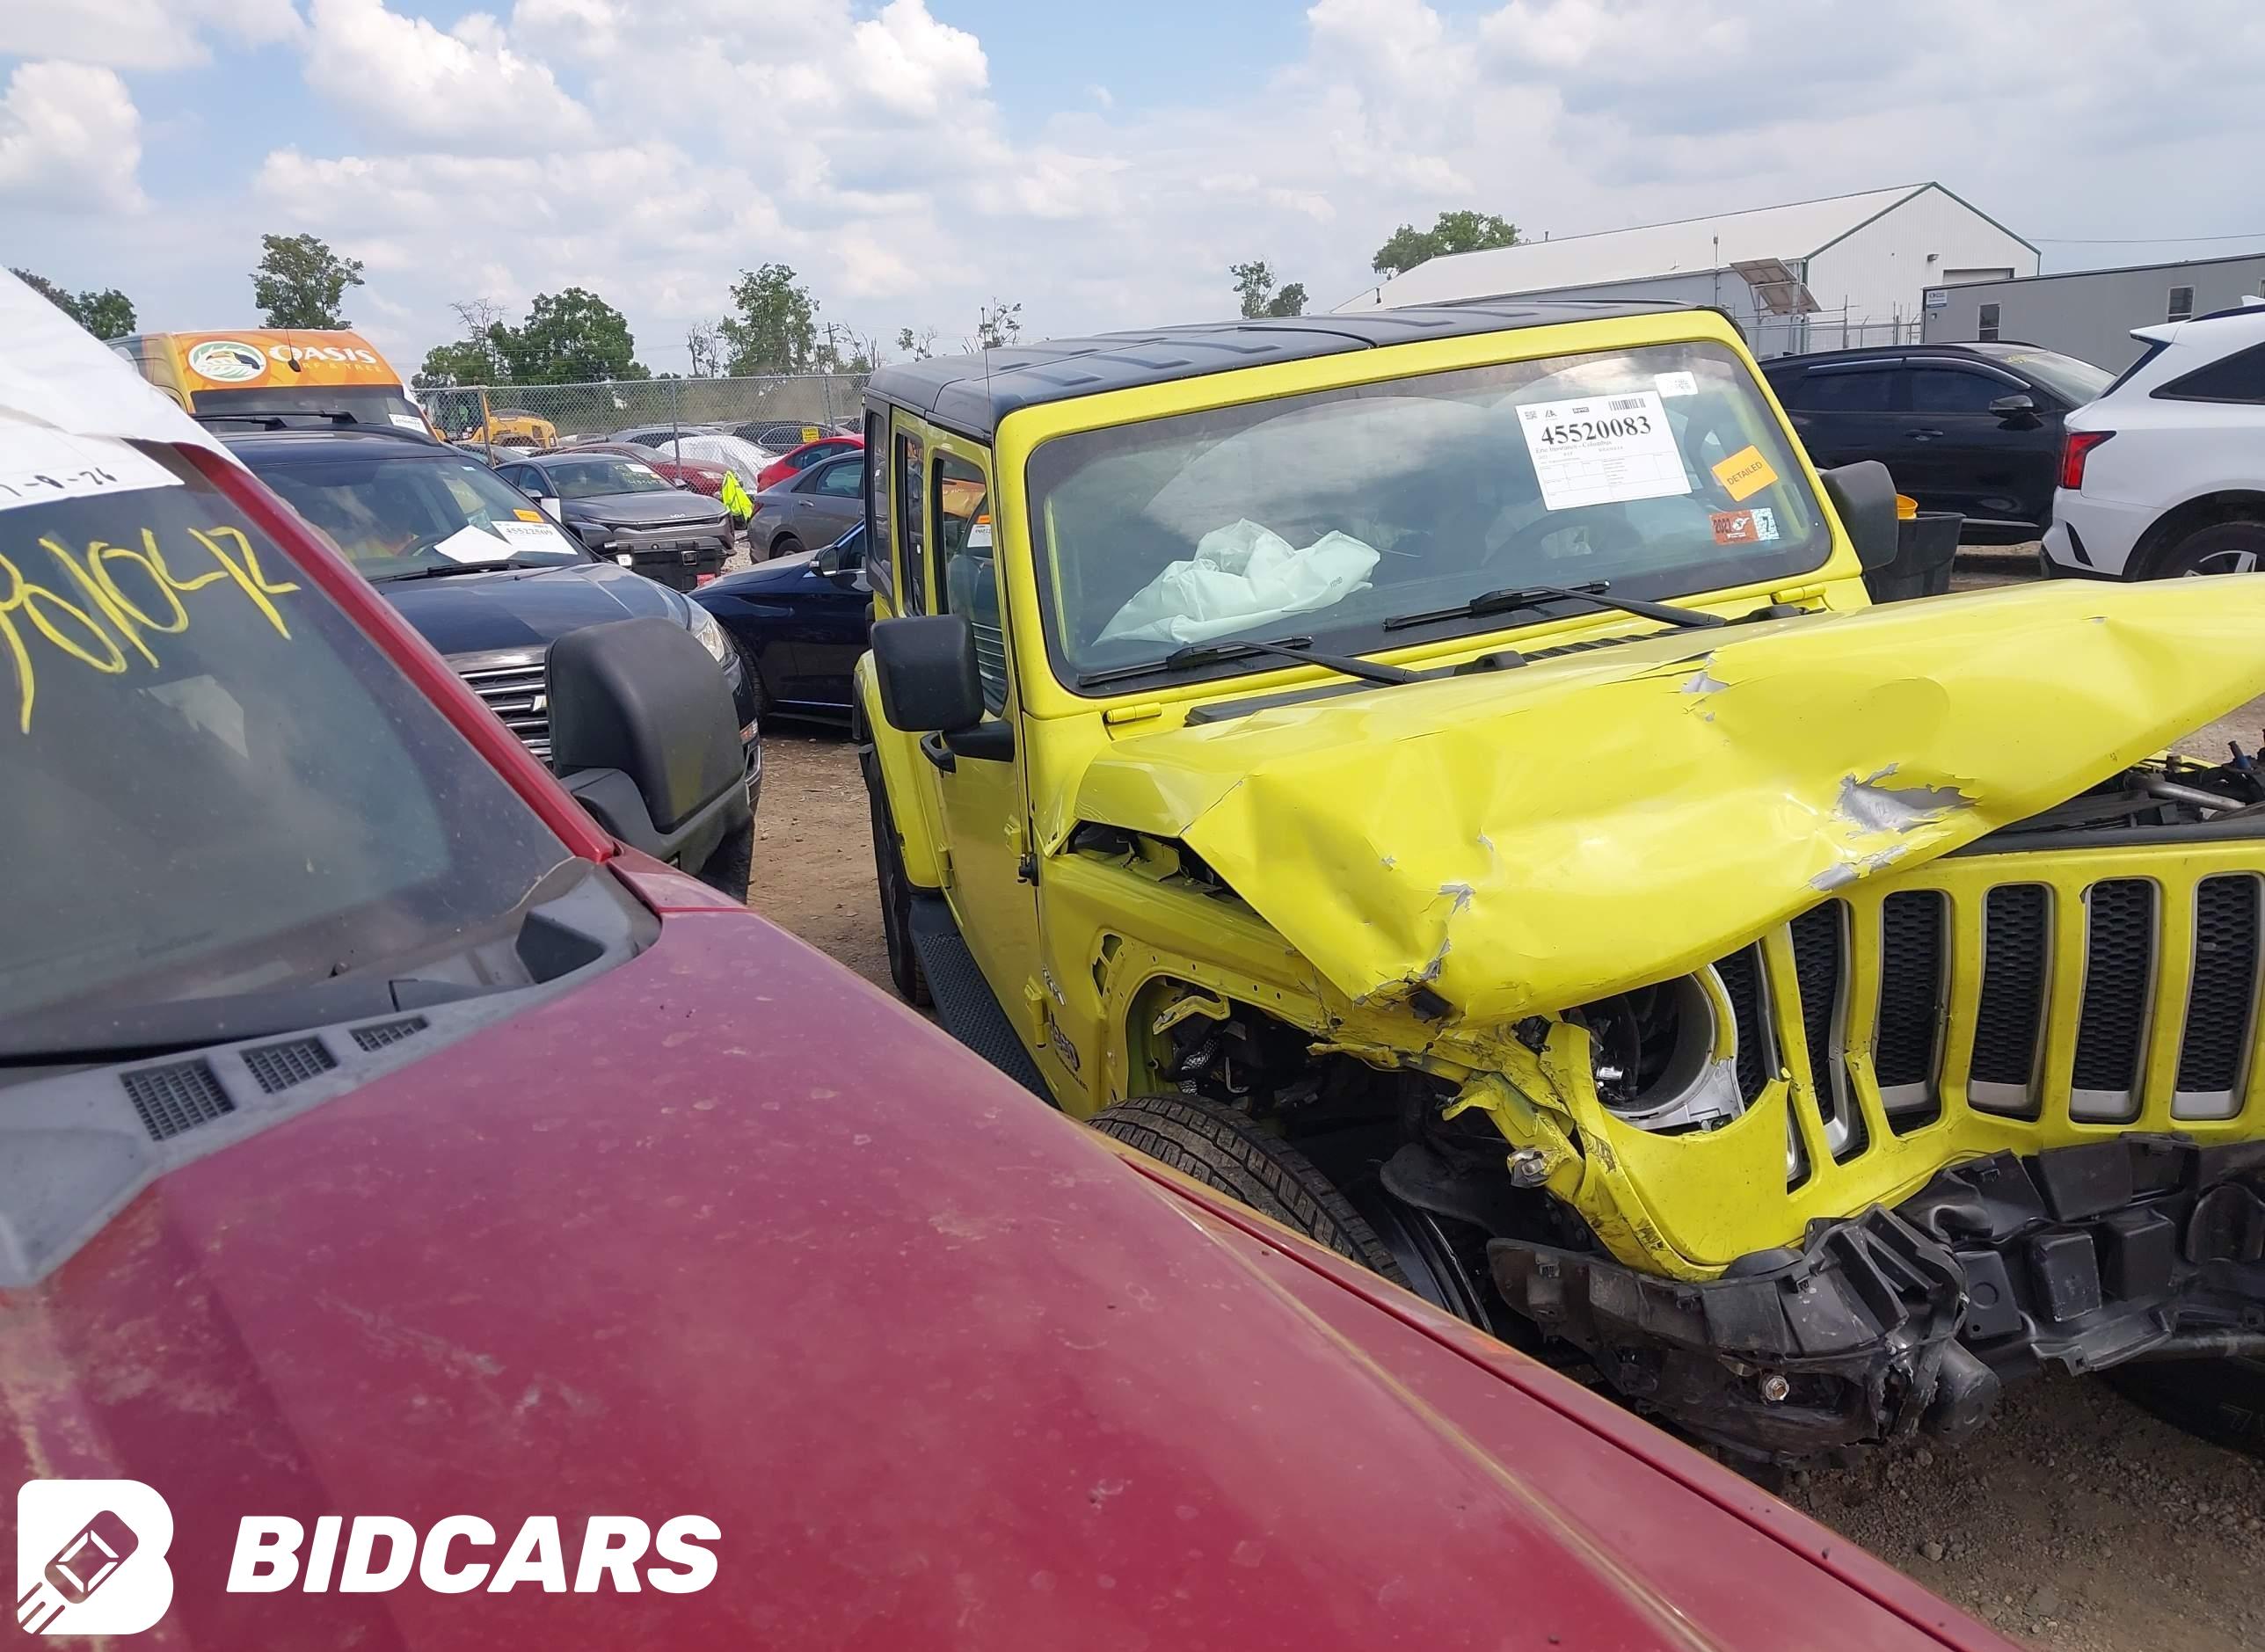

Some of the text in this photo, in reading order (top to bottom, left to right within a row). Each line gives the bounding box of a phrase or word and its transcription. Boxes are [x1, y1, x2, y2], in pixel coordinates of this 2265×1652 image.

[269, 345, 377, 364] OASIS
[344, 363, 382, 373] TREE
[1541, 416, 1651, 445] 45520083
[1727, 461, 1763, 485] DETAILED
[1763, 516, 1769, 532] 7
